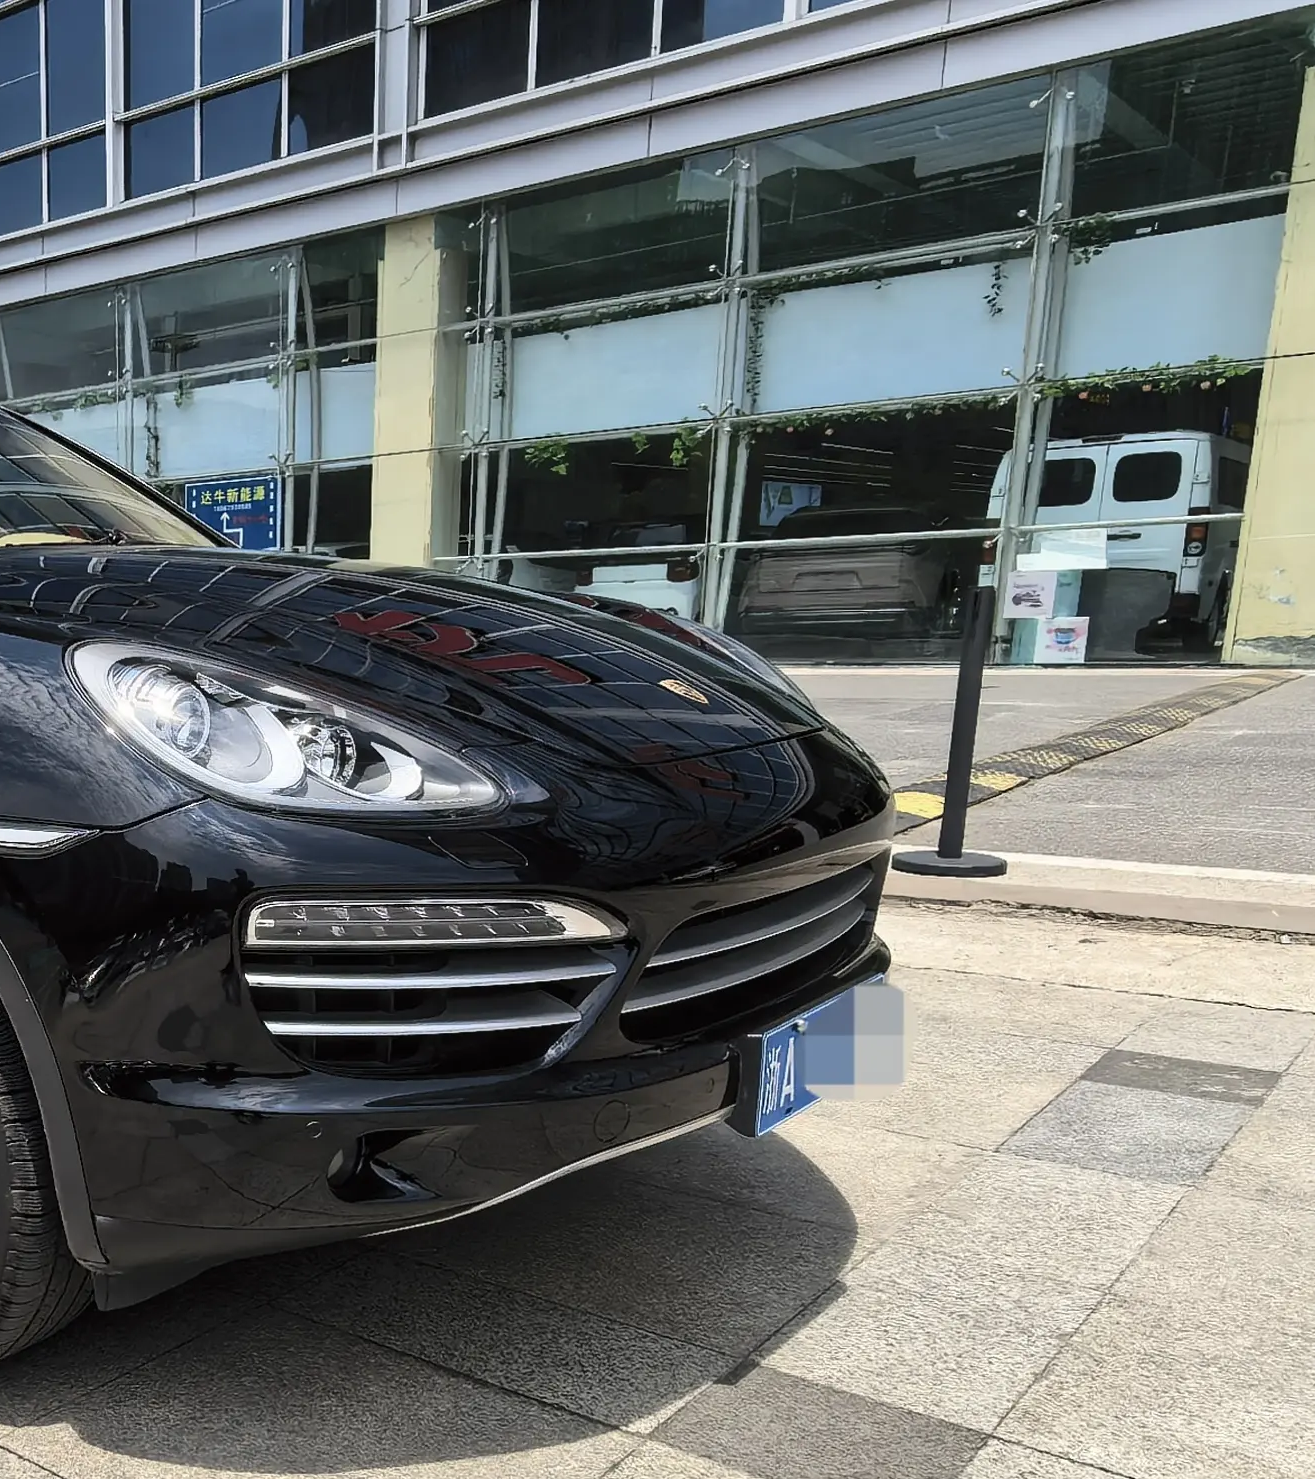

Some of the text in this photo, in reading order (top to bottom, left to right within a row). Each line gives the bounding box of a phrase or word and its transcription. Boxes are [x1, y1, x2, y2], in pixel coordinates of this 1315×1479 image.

[201, 485, 265, 505] 达牛新能源
